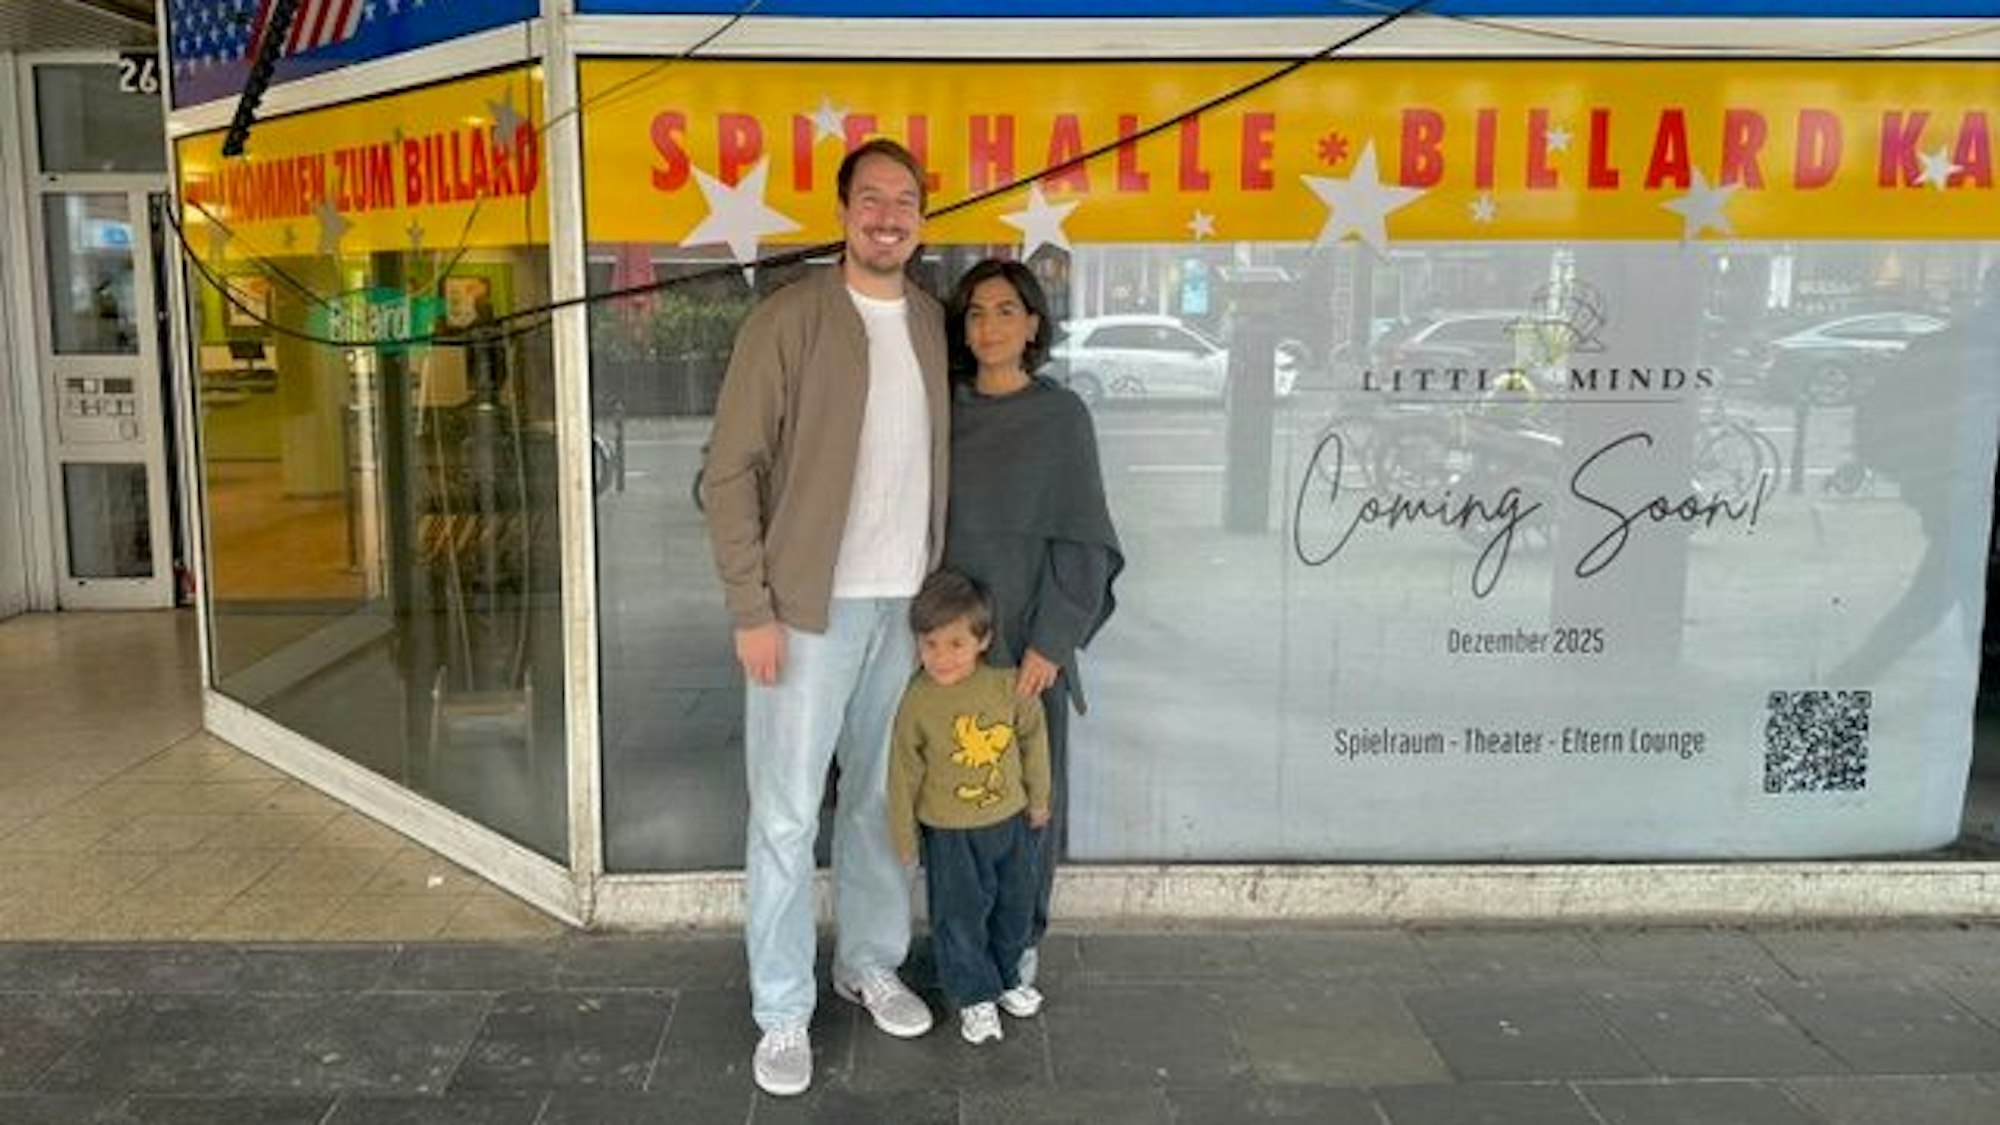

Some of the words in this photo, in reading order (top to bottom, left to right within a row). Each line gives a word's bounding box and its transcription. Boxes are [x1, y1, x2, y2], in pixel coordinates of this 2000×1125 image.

[119, 57, 158, 94] 26
[185, 153, 326, 222] KOMMEN
[334, 142, 395, 213] ZUM
[403, 120, 539, 206] BILLARD
[1360, 367, 1528, 391] LITTLE
[1569, 367, 1714, 391] MINDS
[1294, 433, 1542, 598] Coming
[1570, 433, 1768, 578] Soon!
[1448, 628, 1548, 654] Dezember
[1552, 627, 1605, 654] 2025
[1334, 727, 1446, 760] Spielraum
[1463, 727, 1544, 754] Theater
[1562, 727, 1624, 754] Eltern
[1629, 727, 1706, 760] Lounge
